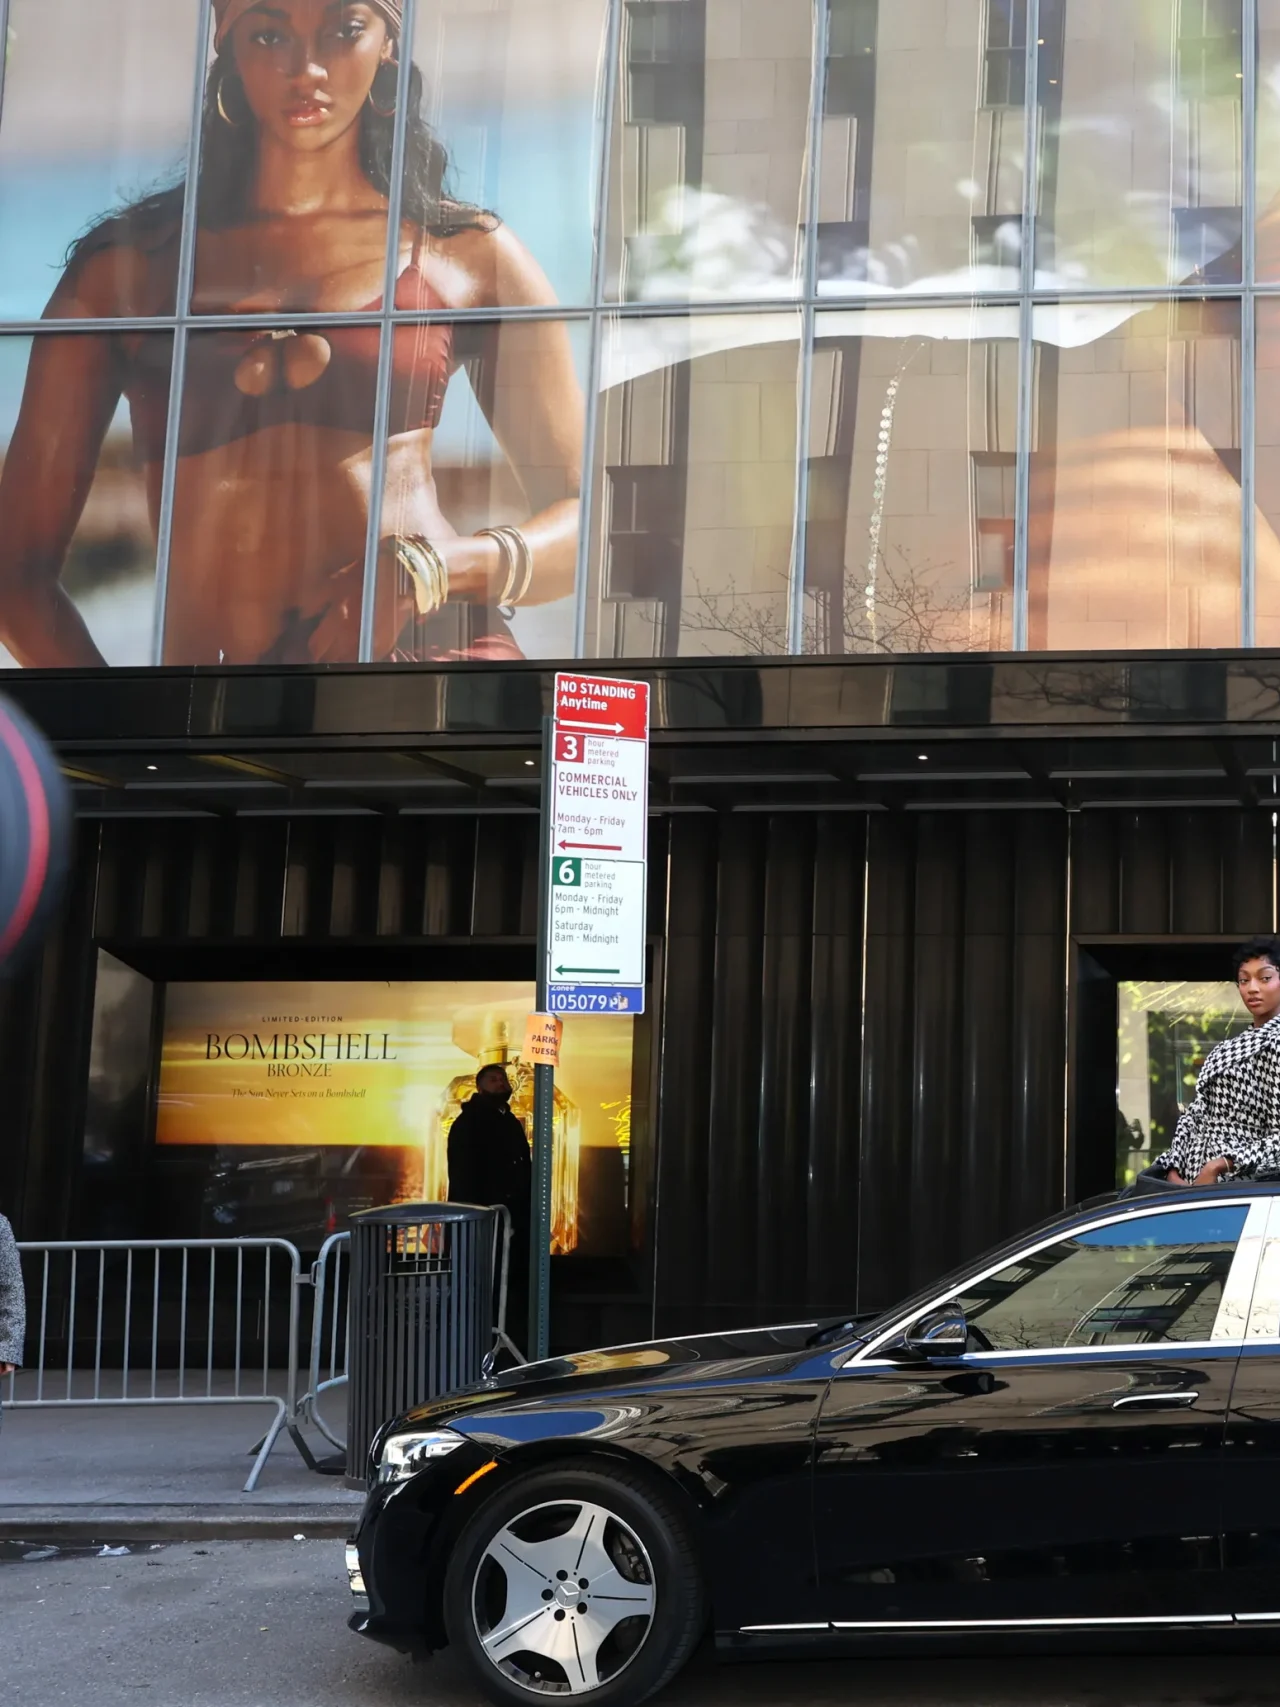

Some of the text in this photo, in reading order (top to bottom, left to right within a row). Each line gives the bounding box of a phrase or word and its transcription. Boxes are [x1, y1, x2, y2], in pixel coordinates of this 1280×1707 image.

[561, 681, 636, 699] NO STANDING
[560, 695, 608, 711] Anytime
[562, 735, 578, 760] 3
[588, 739, 605, 748] hour
[588, 748, 619, 758] metered
[587, 758, 615, 767] parking
[558, 771, 628, 788] COMMERCIAL
[558, 785, 638, 801] VEHICLES ONLY
[557, 812, 592, 825] Monday
[599, 815, 626, 828] Friday
[557, 824, 576, 834] 7am
[584, 826, 603, 836] 6pm
[558, 859, 575, 885] 6
[584, 862, 602, 870] hour
[584, 872, 616, 880] metered
[584, 881, 612, 890] parking
[555, 892, 589, 904] Monday
[597, 894, 624, 906] Friday
[555, 904, 574, 914] 6pm
[582, 905, 619, 918] Midnight
[555, 920, 594, 932] Saturday
[554, 932, 574, 942] 8am
[582, 933, 619, 945] Midnight
[550, 994, 608, 1010] 105079
[205, 1033, 397, 1060] BOMBSHELL
[267, 1063, 333, 1078] BRONZE
[231, 1088, 247, 1098] The
[248, 1088, 264, 1098] Sun
[265, 1088, 289, 1098] Never
[290, 1088, 307, 1098] Sets
[325, 1088, 367, 1098] Bombshell
